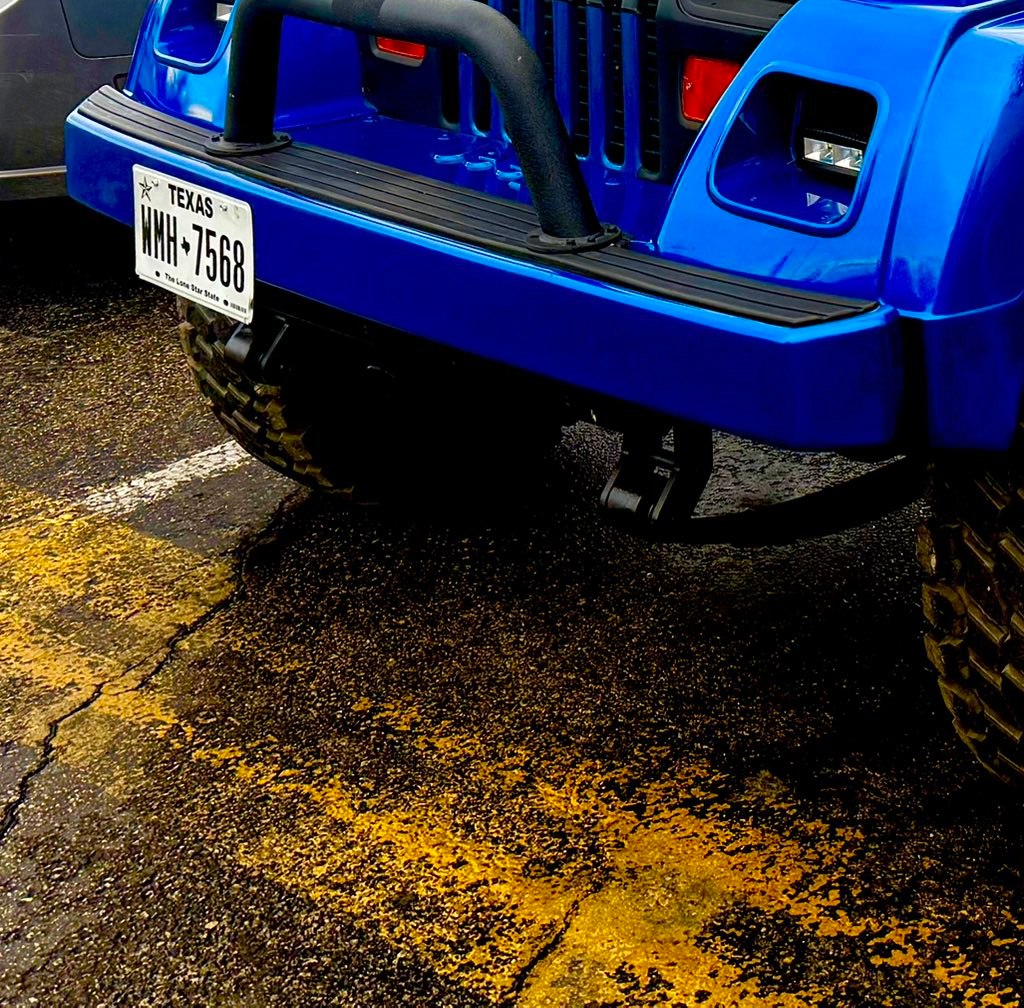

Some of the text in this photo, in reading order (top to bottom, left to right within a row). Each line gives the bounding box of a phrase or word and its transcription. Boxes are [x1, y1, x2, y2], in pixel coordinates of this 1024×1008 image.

[168, 183, 214, 219] TEXAS
[165, 272, 220, 302] The Lone Star State
